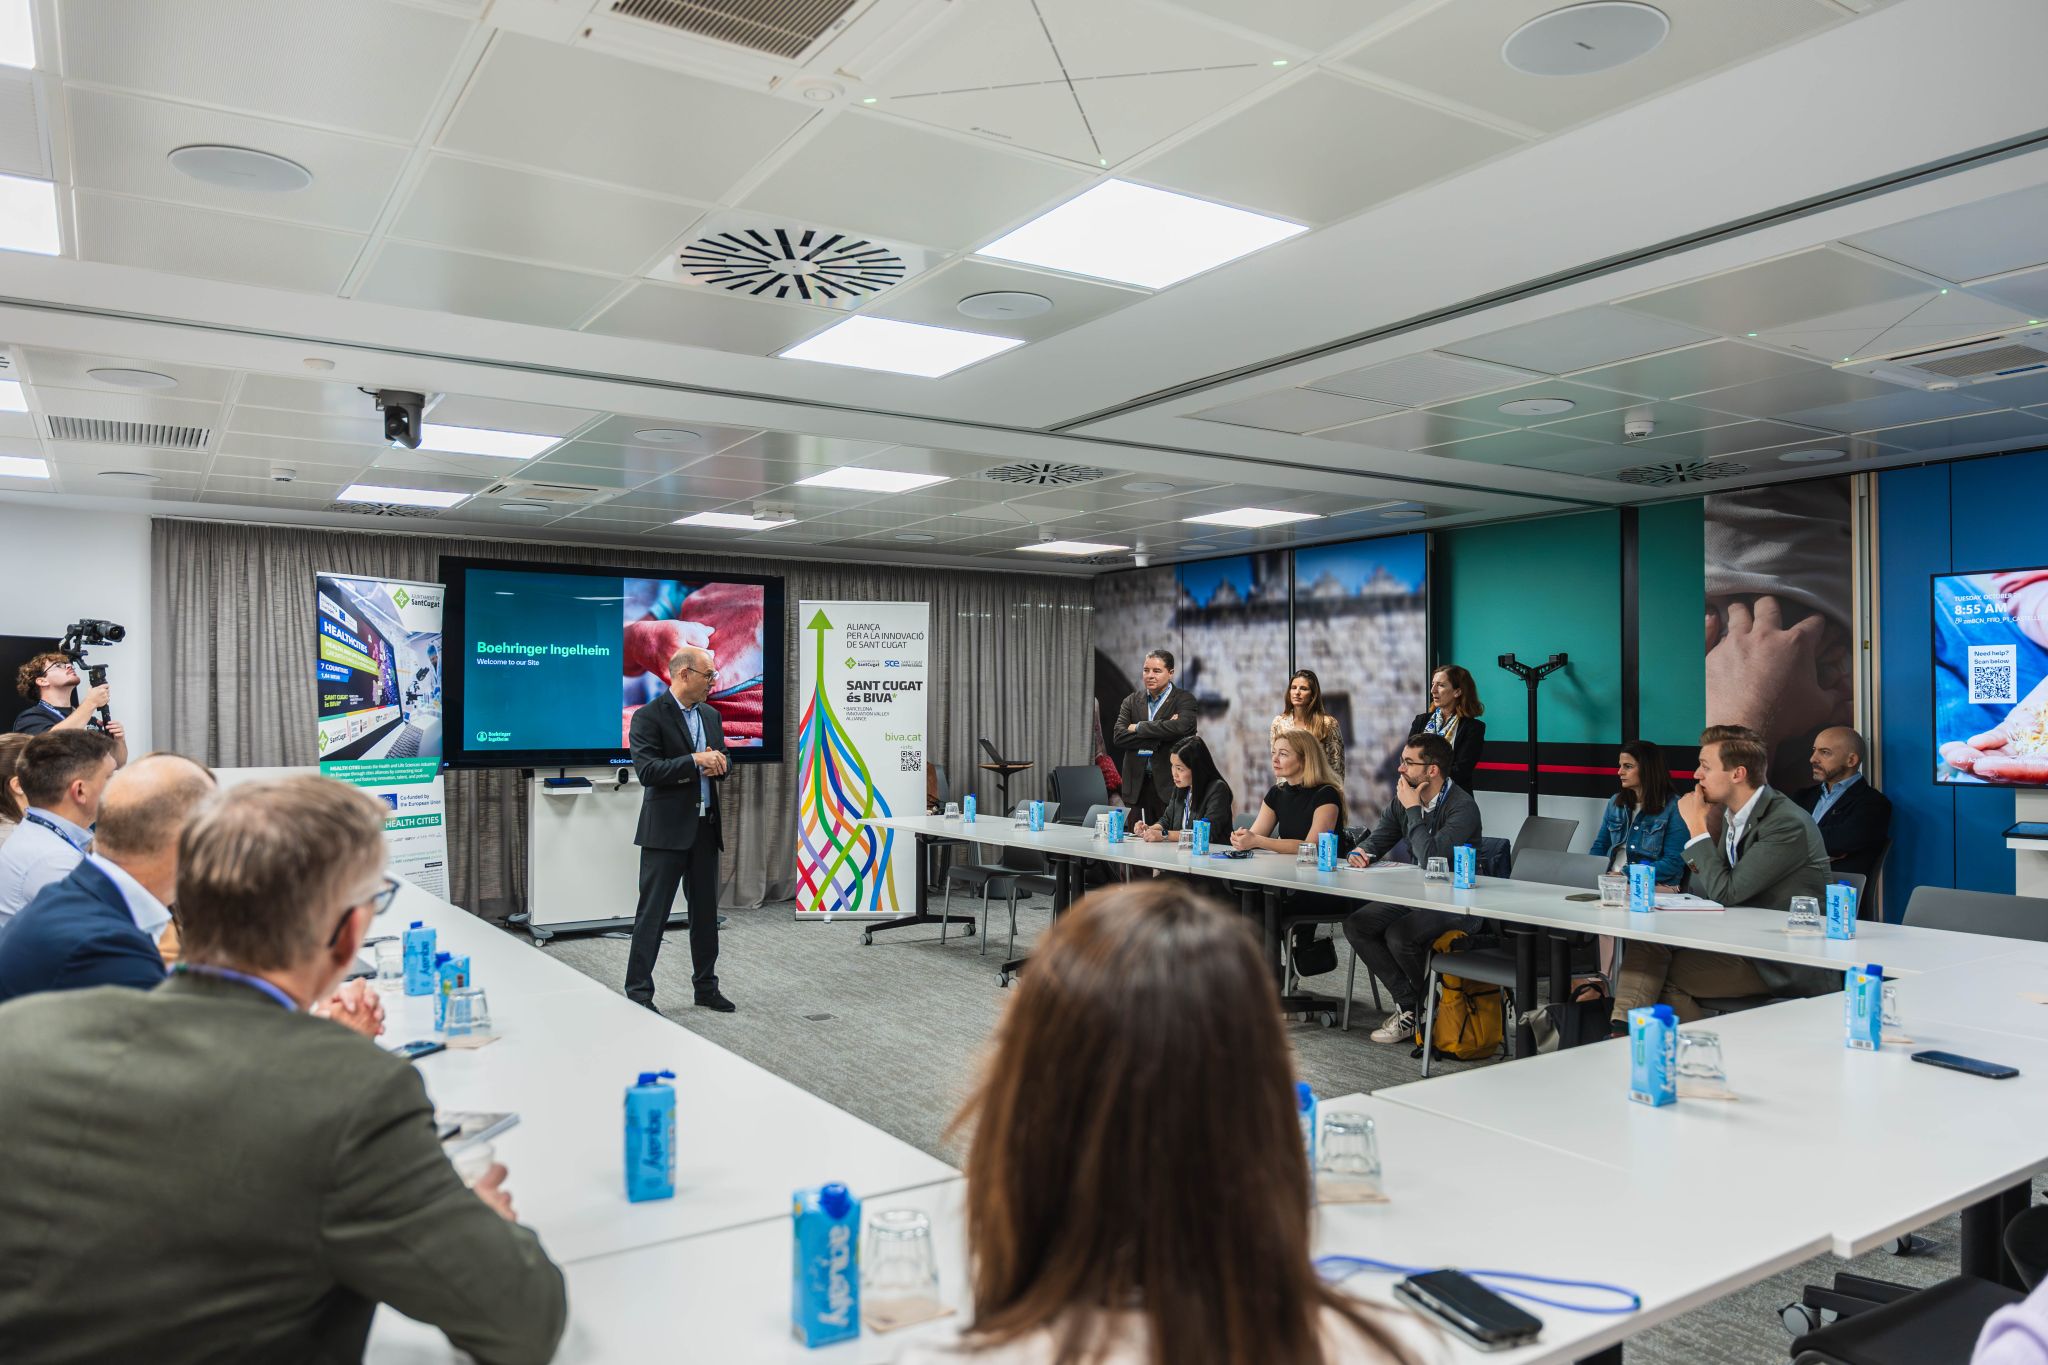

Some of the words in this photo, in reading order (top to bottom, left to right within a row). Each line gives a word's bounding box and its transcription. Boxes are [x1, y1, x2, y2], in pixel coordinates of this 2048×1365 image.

[411, 598, 440, 608] SantCugat
[1954, 604, 1981, 615] 8:55
[1984, 603, 2007, 614] AM
[846, 623, 881, 632] ALIANÇA
[846, 632, 862, 640] PER
[863, 632, 869, 640] A
[870, 632, 881, 640] LA
[881, 632, 924, 640] INNOVACIÓ
[477, 642, 548, 657] Boehringer
[550, 643, 610, 657] Ingelheim
[846, 680, 881, 691] SANT
[882, 680, 923, 691] CUGAT
[846, 692, 861, 703] és
[885, 732, 922, 741] biva.cat
[385, 818, 415, 828] HEALTH
[416, 816, 439, 825] CITIES
